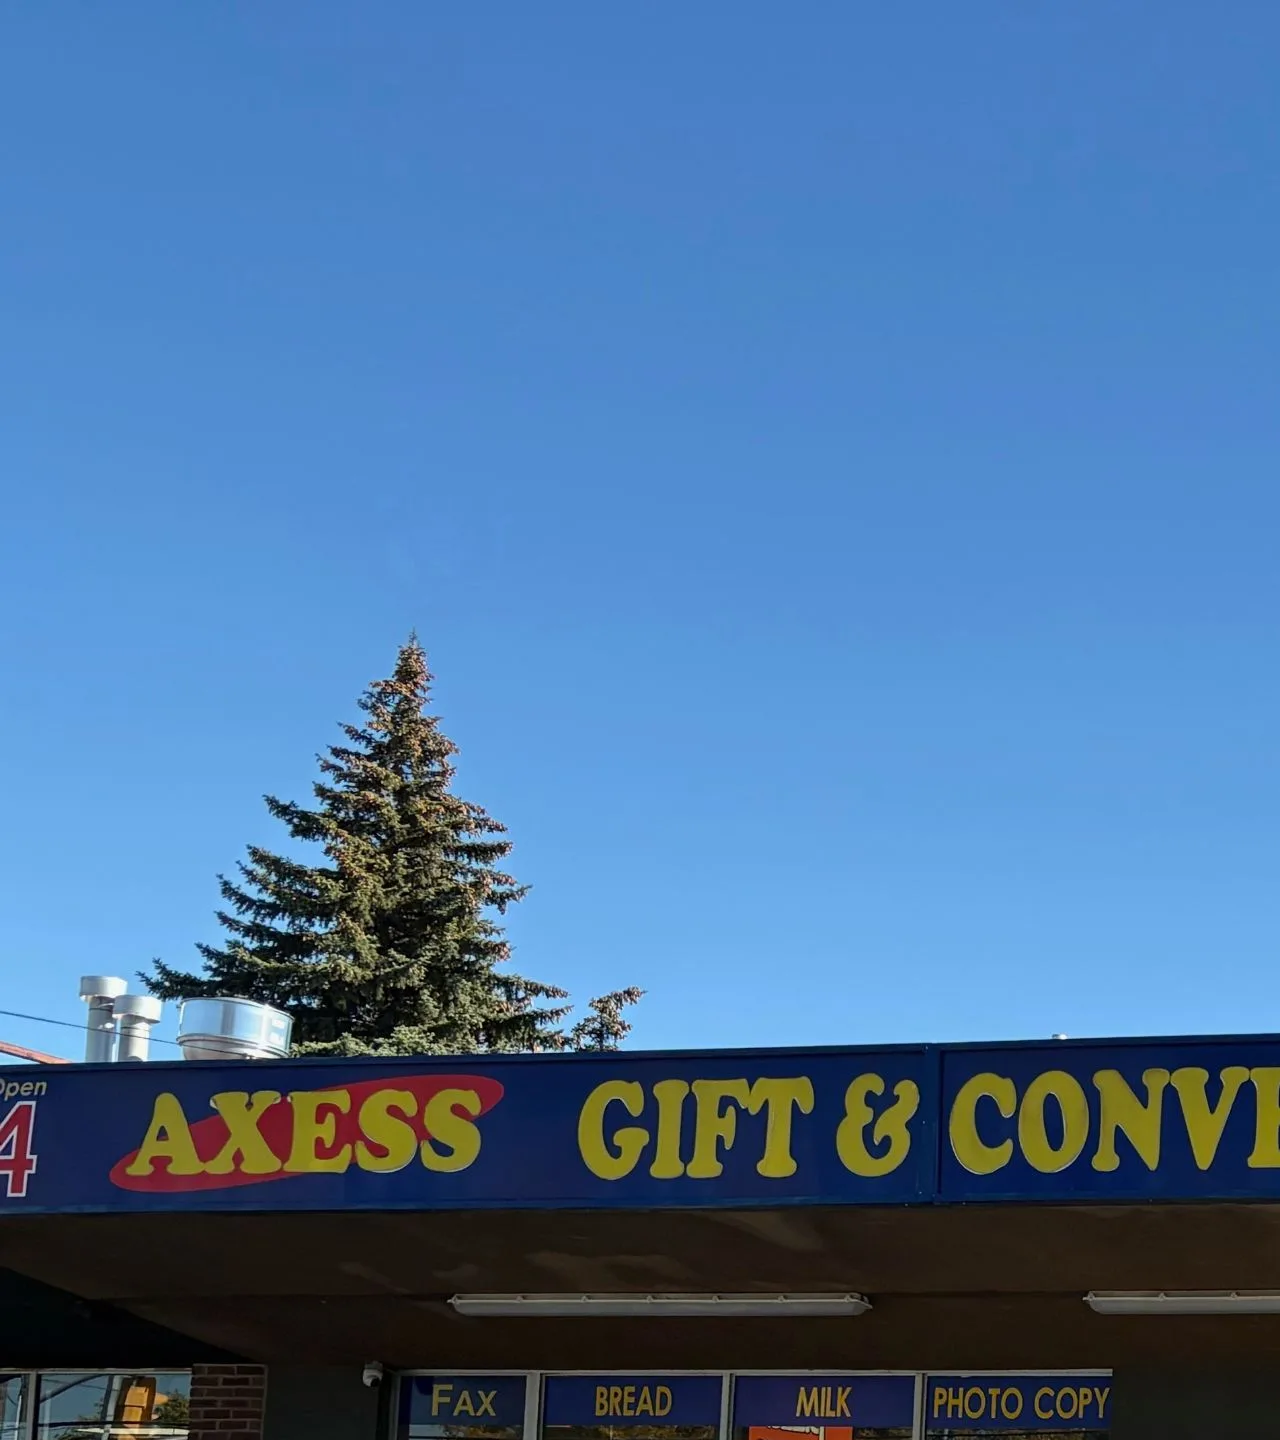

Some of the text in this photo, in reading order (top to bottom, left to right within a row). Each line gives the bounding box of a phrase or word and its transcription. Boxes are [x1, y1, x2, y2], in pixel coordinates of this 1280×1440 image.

[125, 1088, 483, 1176] AXESS
[578, 1076, 814, 1180] GIFT
[837, 1073, 920, 1178] &
[431, 1384, 497, 1417] FAX
[595, 1385, 673, 1417] BREAD
[795, 1386, 853, 1418] MILK
[933, 1387, 1111, 1419] PHOTO COPY
